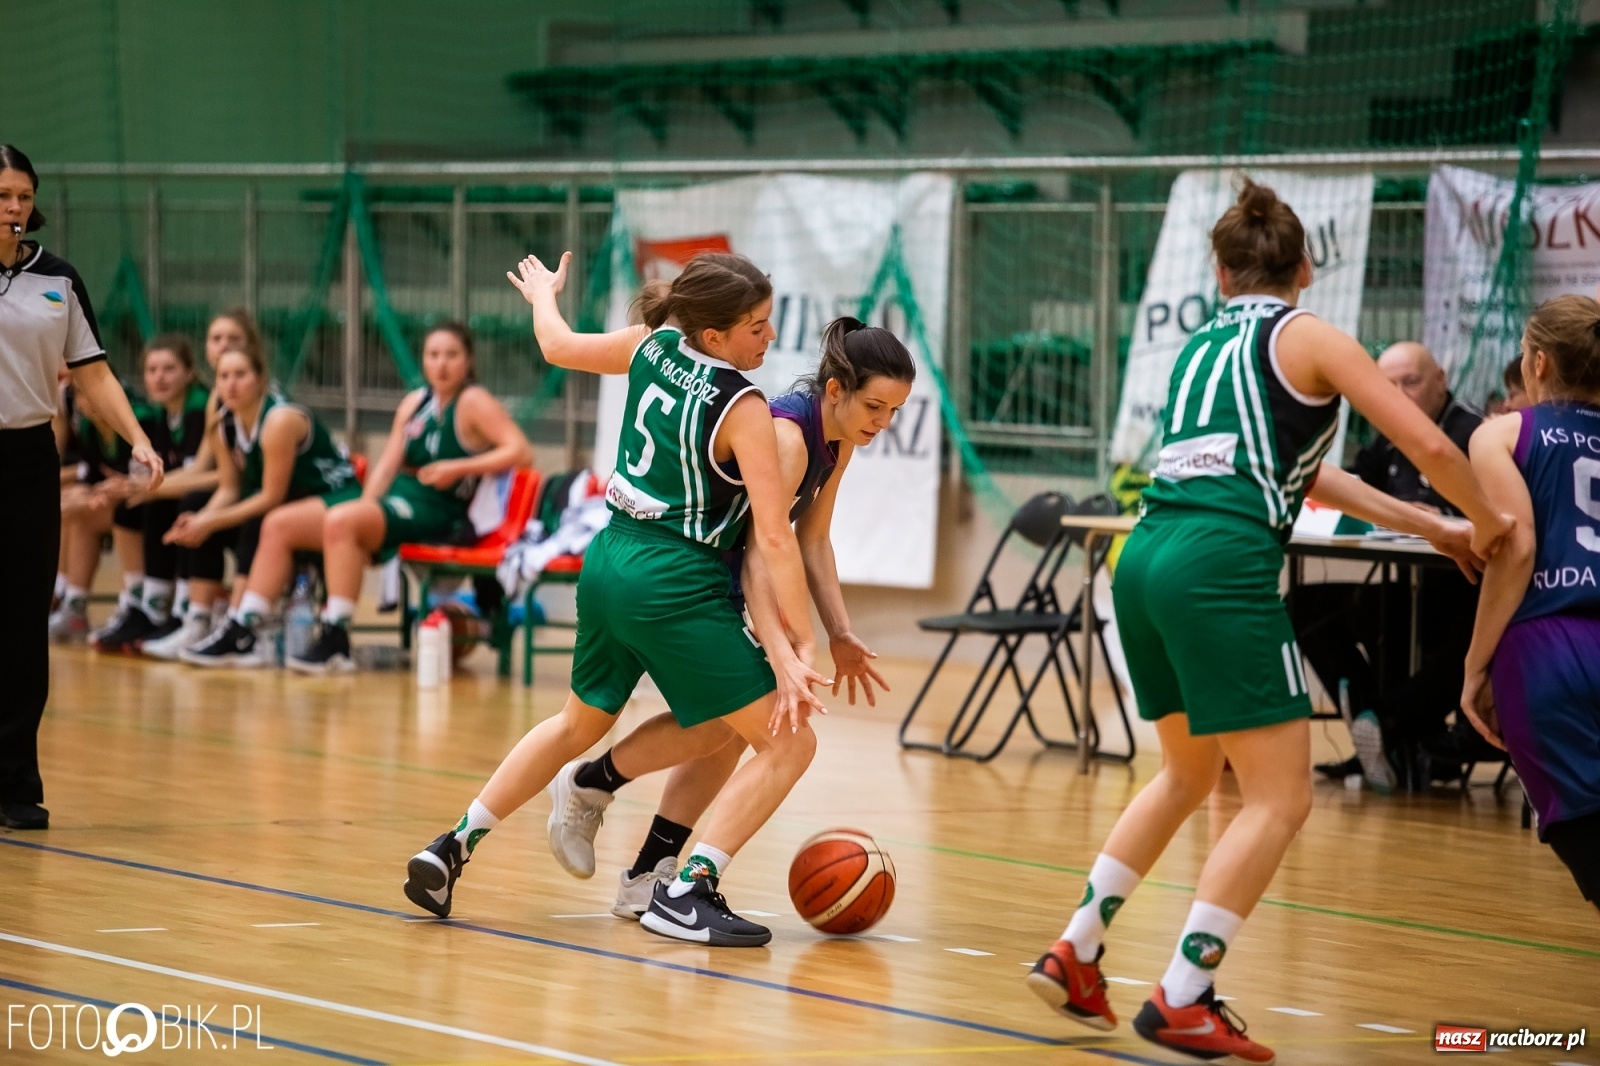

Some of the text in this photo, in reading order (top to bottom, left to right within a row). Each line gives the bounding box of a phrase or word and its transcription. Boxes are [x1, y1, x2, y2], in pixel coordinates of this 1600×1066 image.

[641, 339, 721, 406] RKK RACIBÓRZ
[625, 382, 677, 477] 5
[1540, 427, 1569, 447] KS
